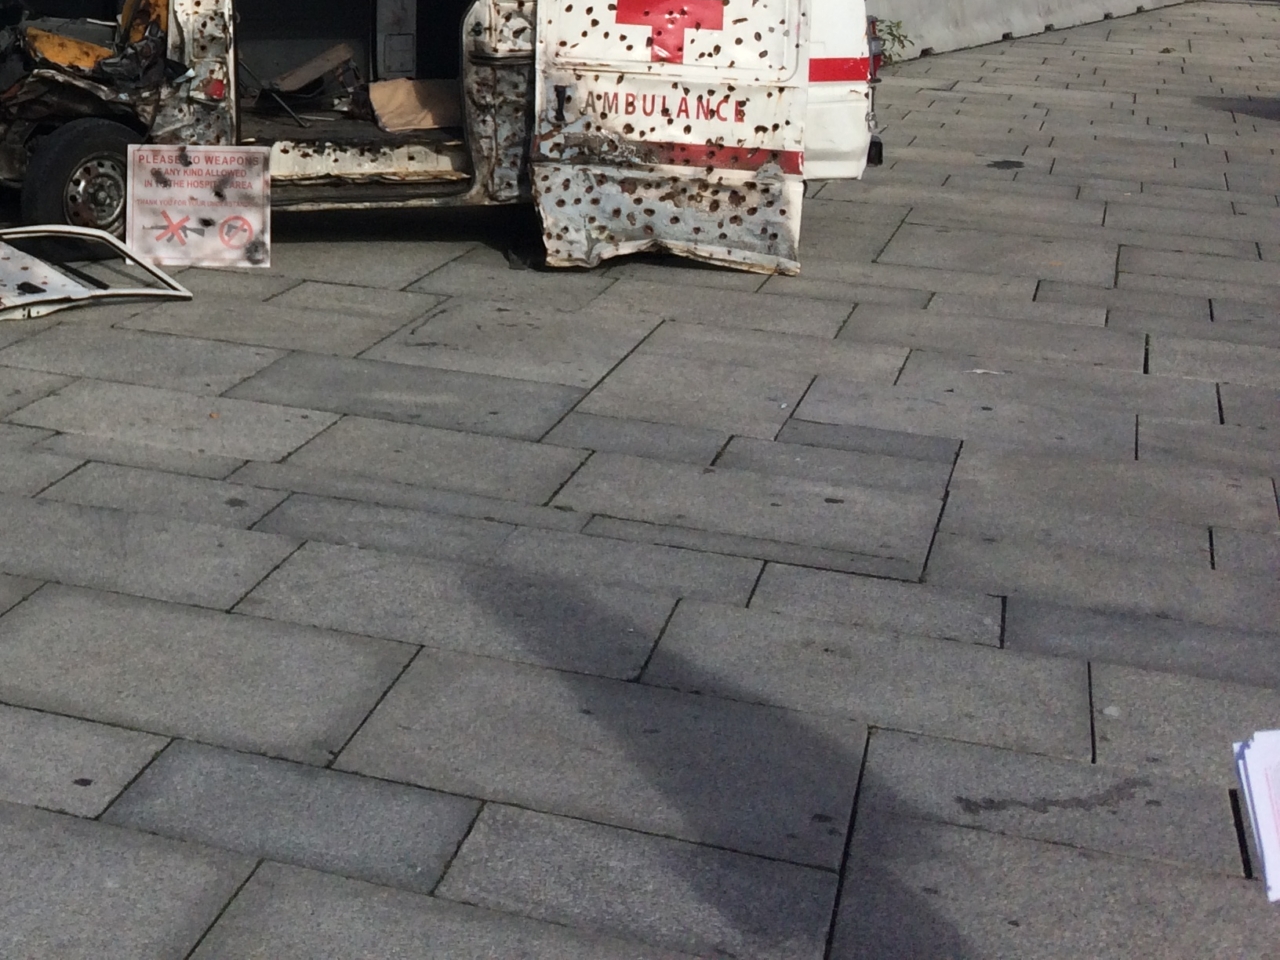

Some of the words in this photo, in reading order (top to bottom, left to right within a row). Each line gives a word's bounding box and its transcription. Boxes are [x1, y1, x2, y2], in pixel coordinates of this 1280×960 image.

[584, 91, 744, 122] AMBULANCE
[138, 154, 180, 164] PLEASE
[205, 156, 259, 166] WEAPONS
[164, 168, 182, 176] ANY
[184, 168, 203, 176] KIND
[205, 169, 247, 177] ALLOWED
[144, 179, 153, 188] IN
[230, 181, 253, 189] AREA
